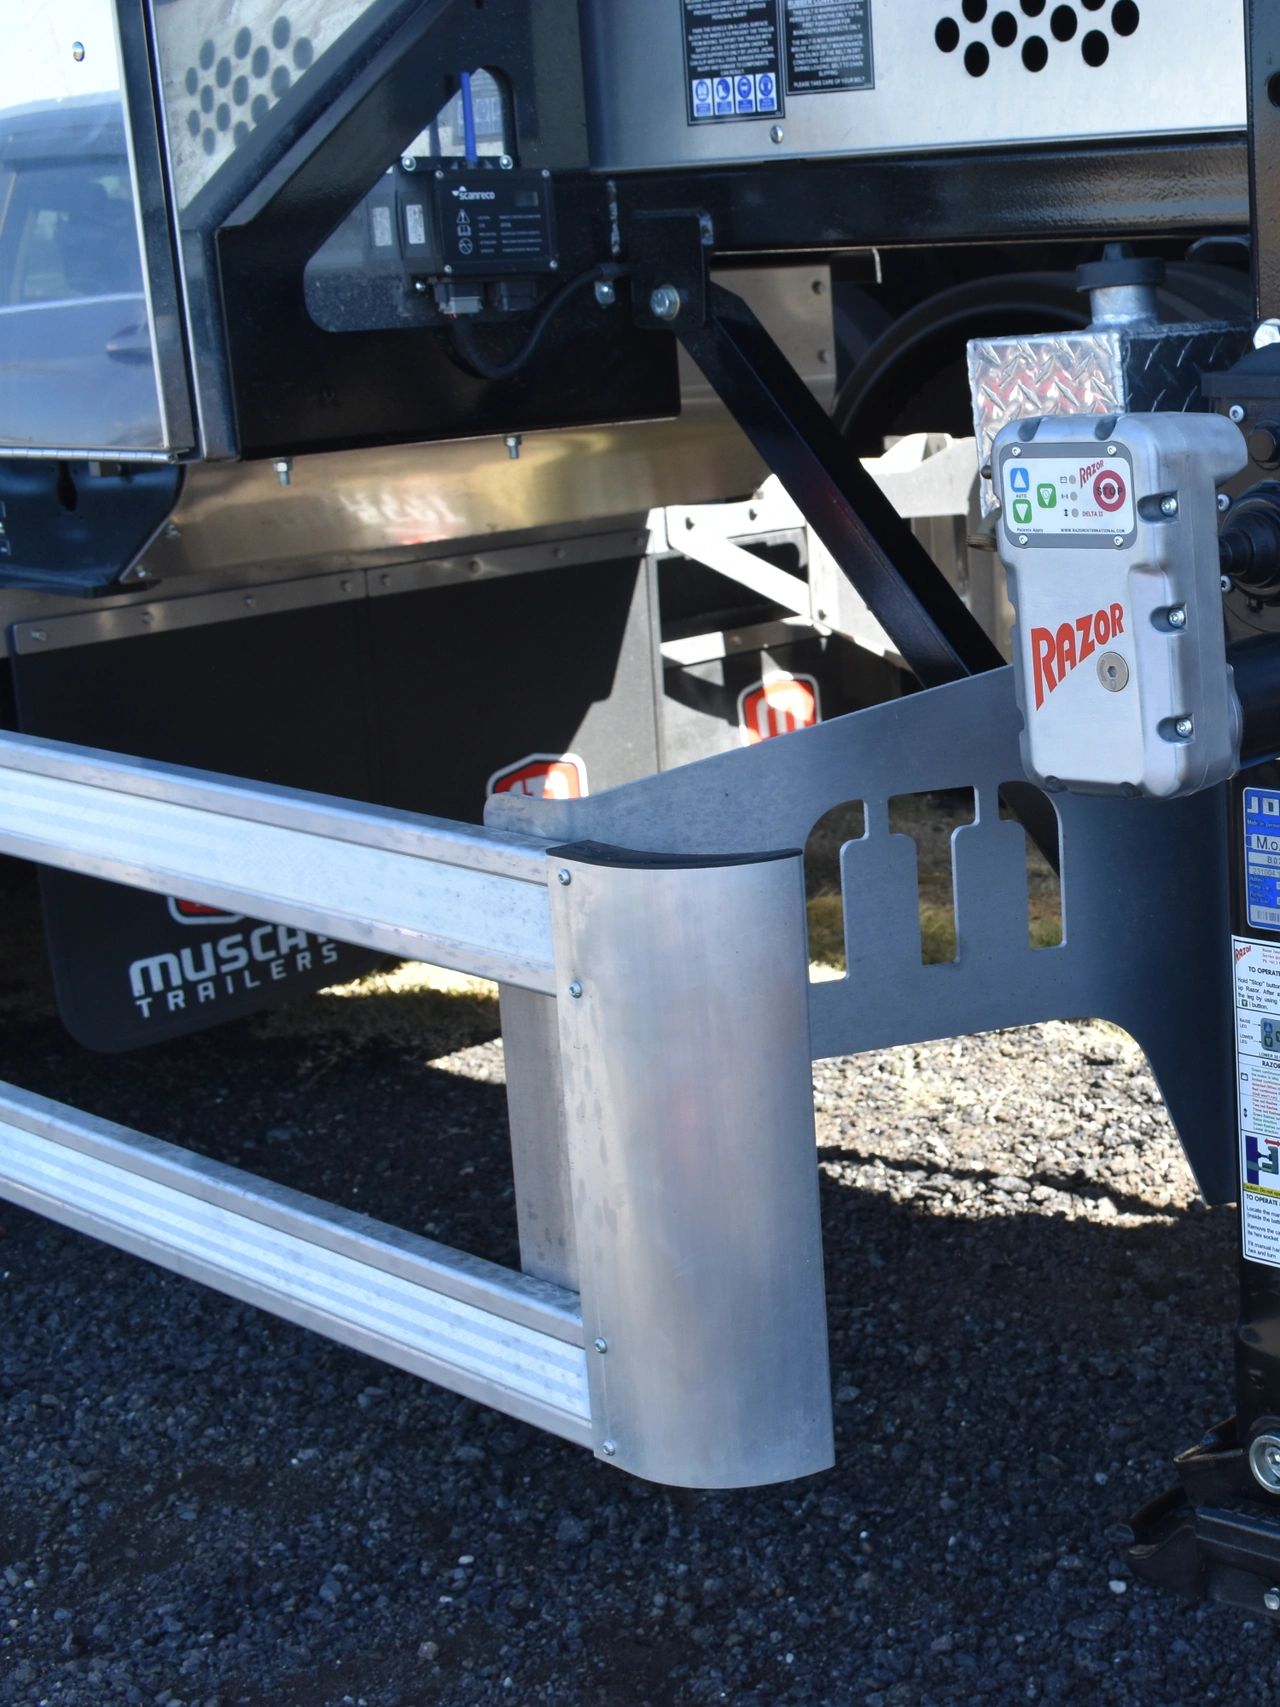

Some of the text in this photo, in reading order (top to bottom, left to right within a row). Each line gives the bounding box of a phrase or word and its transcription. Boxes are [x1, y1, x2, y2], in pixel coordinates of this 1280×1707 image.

[459, 190, 495, 200] scanreco
[1079, 459, 1105, 489] RAZOR
[1096, 486, 1123, 496] STOP
[1030, 602, 1125, 711] RAZOR
[128, 924, 327, 998] MUSCA
[1257, 967, 1280, 977] OPERATE
[135, 943, 338, 1018] TRAILERS
[1264, 997, 1278, 1005] using
[1254, 1195, 1278, 1207] OPERATE
[1246, 1206, 1262, 1214] Locate
[1247, 1223, 1266, 1233] Remove
